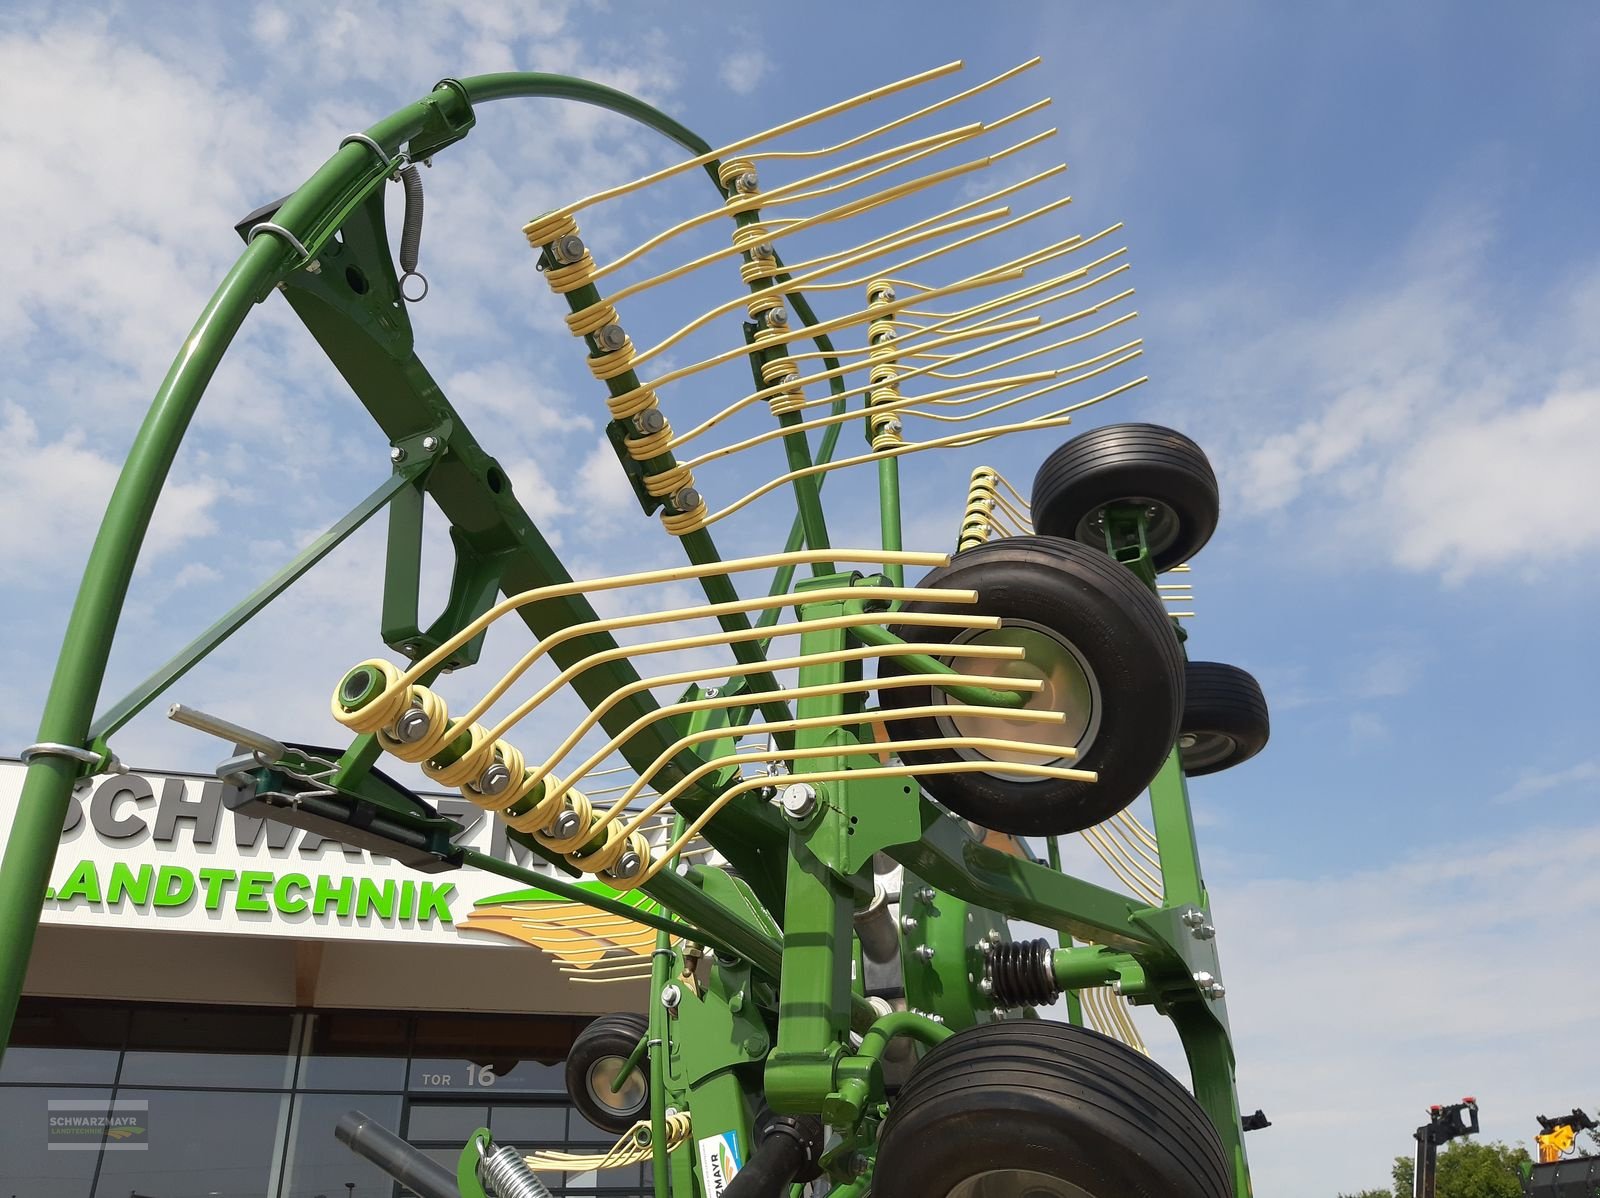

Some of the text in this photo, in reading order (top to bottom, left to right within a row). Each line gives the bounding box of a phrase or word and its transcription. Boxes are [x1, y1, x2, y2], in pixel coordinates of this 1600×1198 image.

[46, 860, 456, 922] ANDTECHNIK
[422, 1064, 495, 1086] TOR 16
